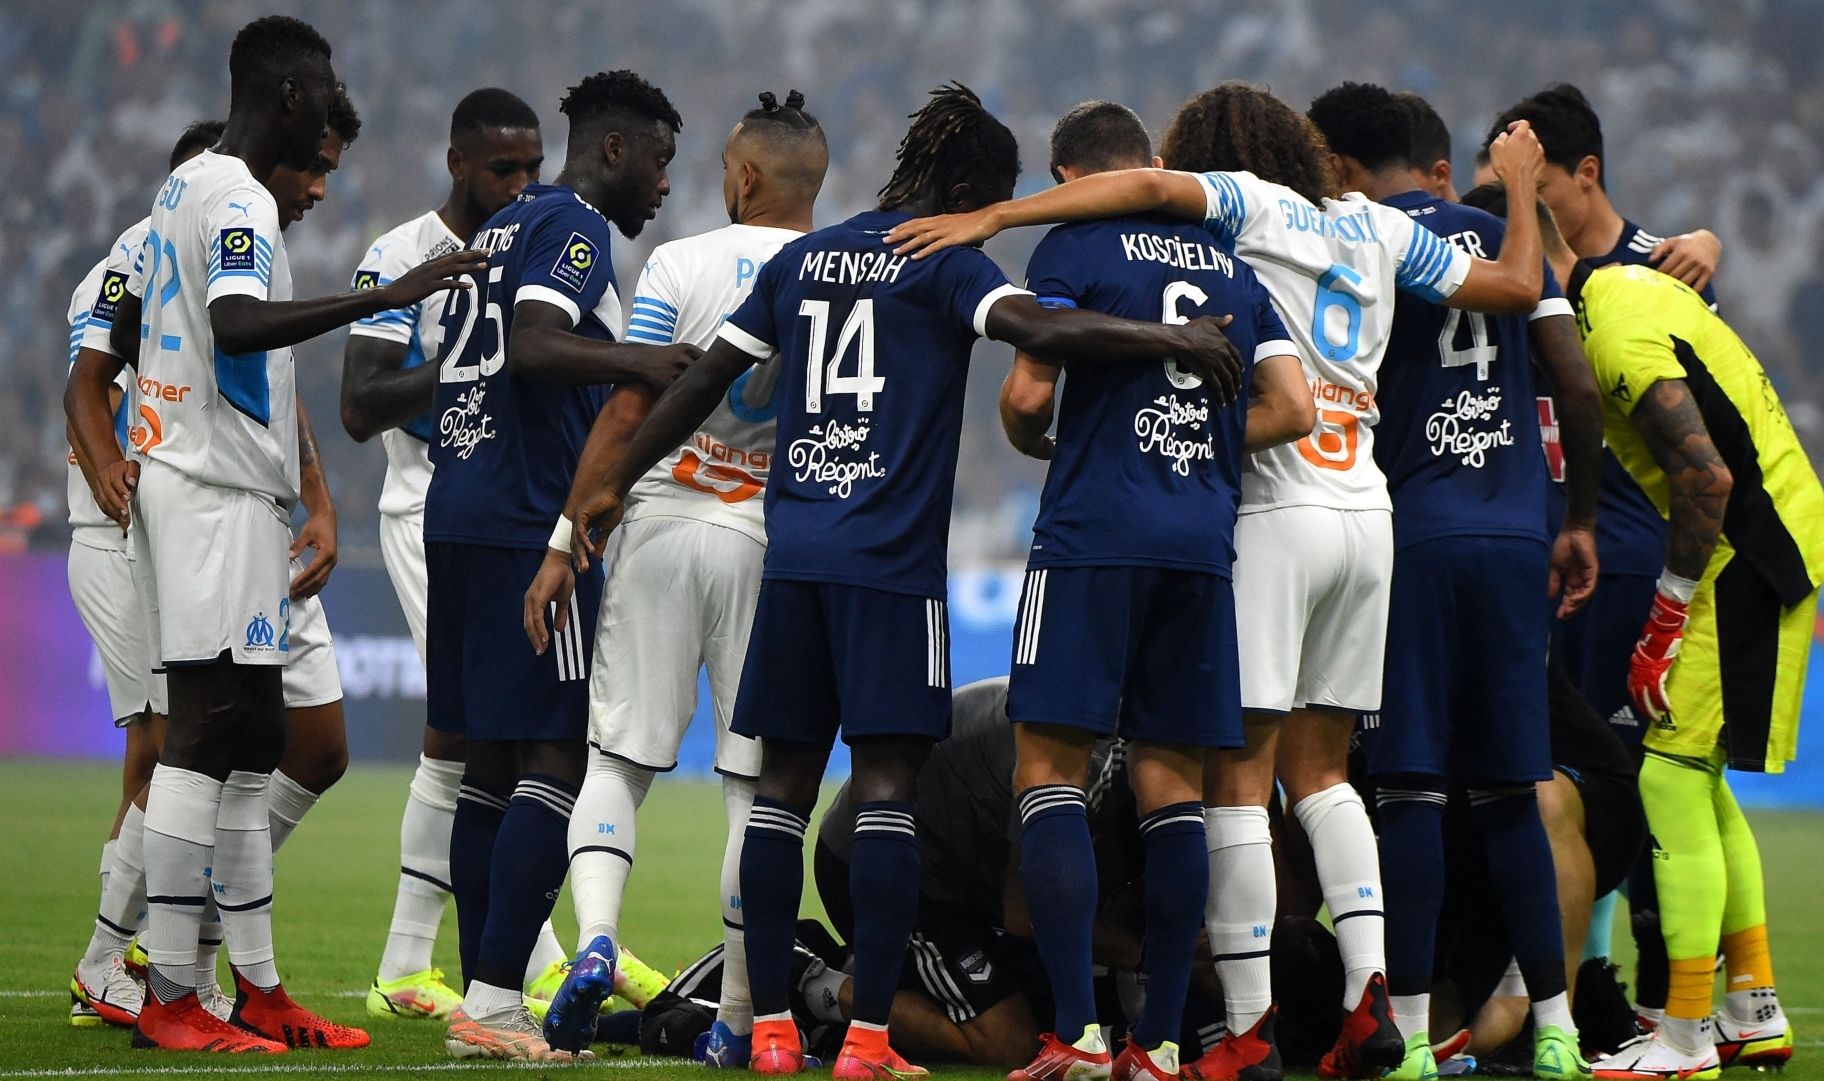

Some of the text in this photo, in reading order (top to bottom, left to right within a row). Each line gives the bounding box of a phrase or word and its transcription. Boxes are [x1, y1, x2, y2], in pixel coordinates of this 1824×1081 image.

[556, 267, 570, 278] Uber
[562, 263, 580, 278] LIGUE
[798, 251, 908, 285] MENSAH
[1440, 230, 1488, 258] ER
[440, 266, 506, 384] 25
[1311, 263, 1362, 362] 6
[798, 298, 886, 414] 14
[1437, 307, 1498, 382] 4
[788, 439, 882, 499] Régent
